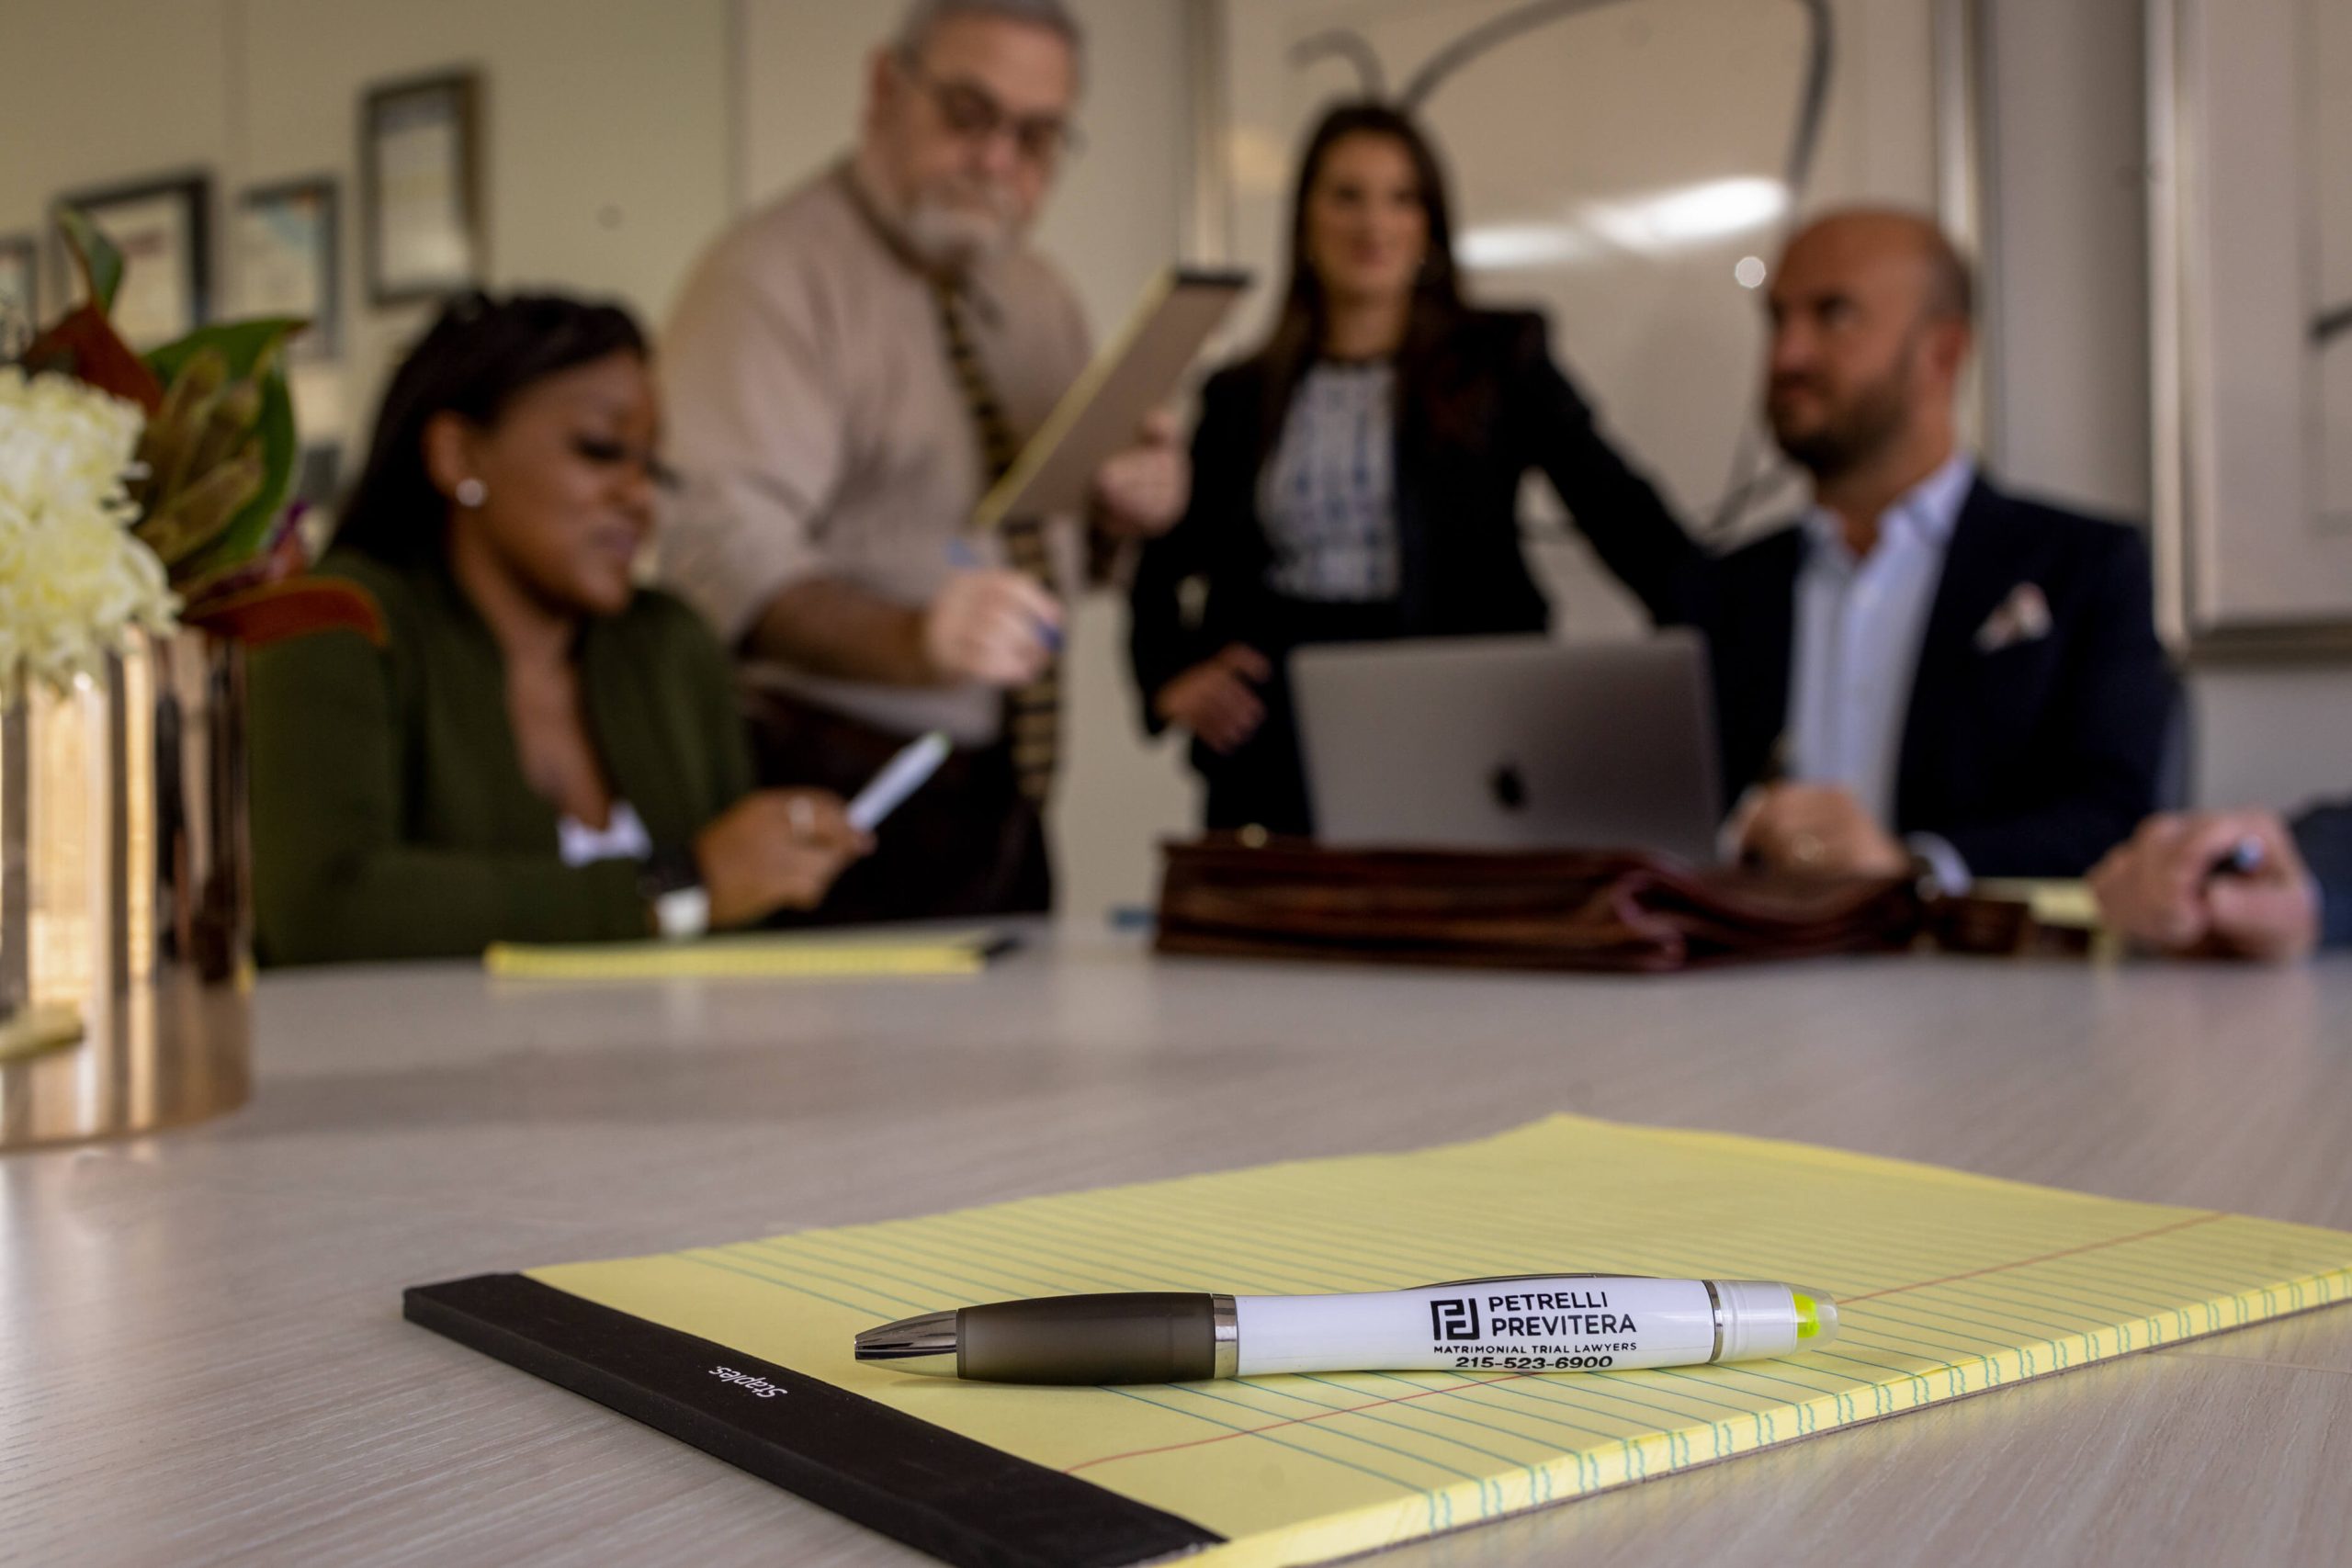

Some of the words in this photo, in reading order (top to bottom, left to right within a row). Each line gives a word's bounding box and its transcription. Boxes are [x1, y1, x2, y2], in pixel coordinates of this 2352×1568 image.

[1488, 1292, 1608, 1312] PETRELLI
[1492, 1314, 1636, 1337] PREVITERA
[1433, 1346, 1526, 1354] MATRIMONIAL
[1532, 1345, 1569, 1353] TRIAL
[1575, 1342, 1637, 1353] LAWYERS
[1455, 1356, 1613, 1369] 215-523-6900
